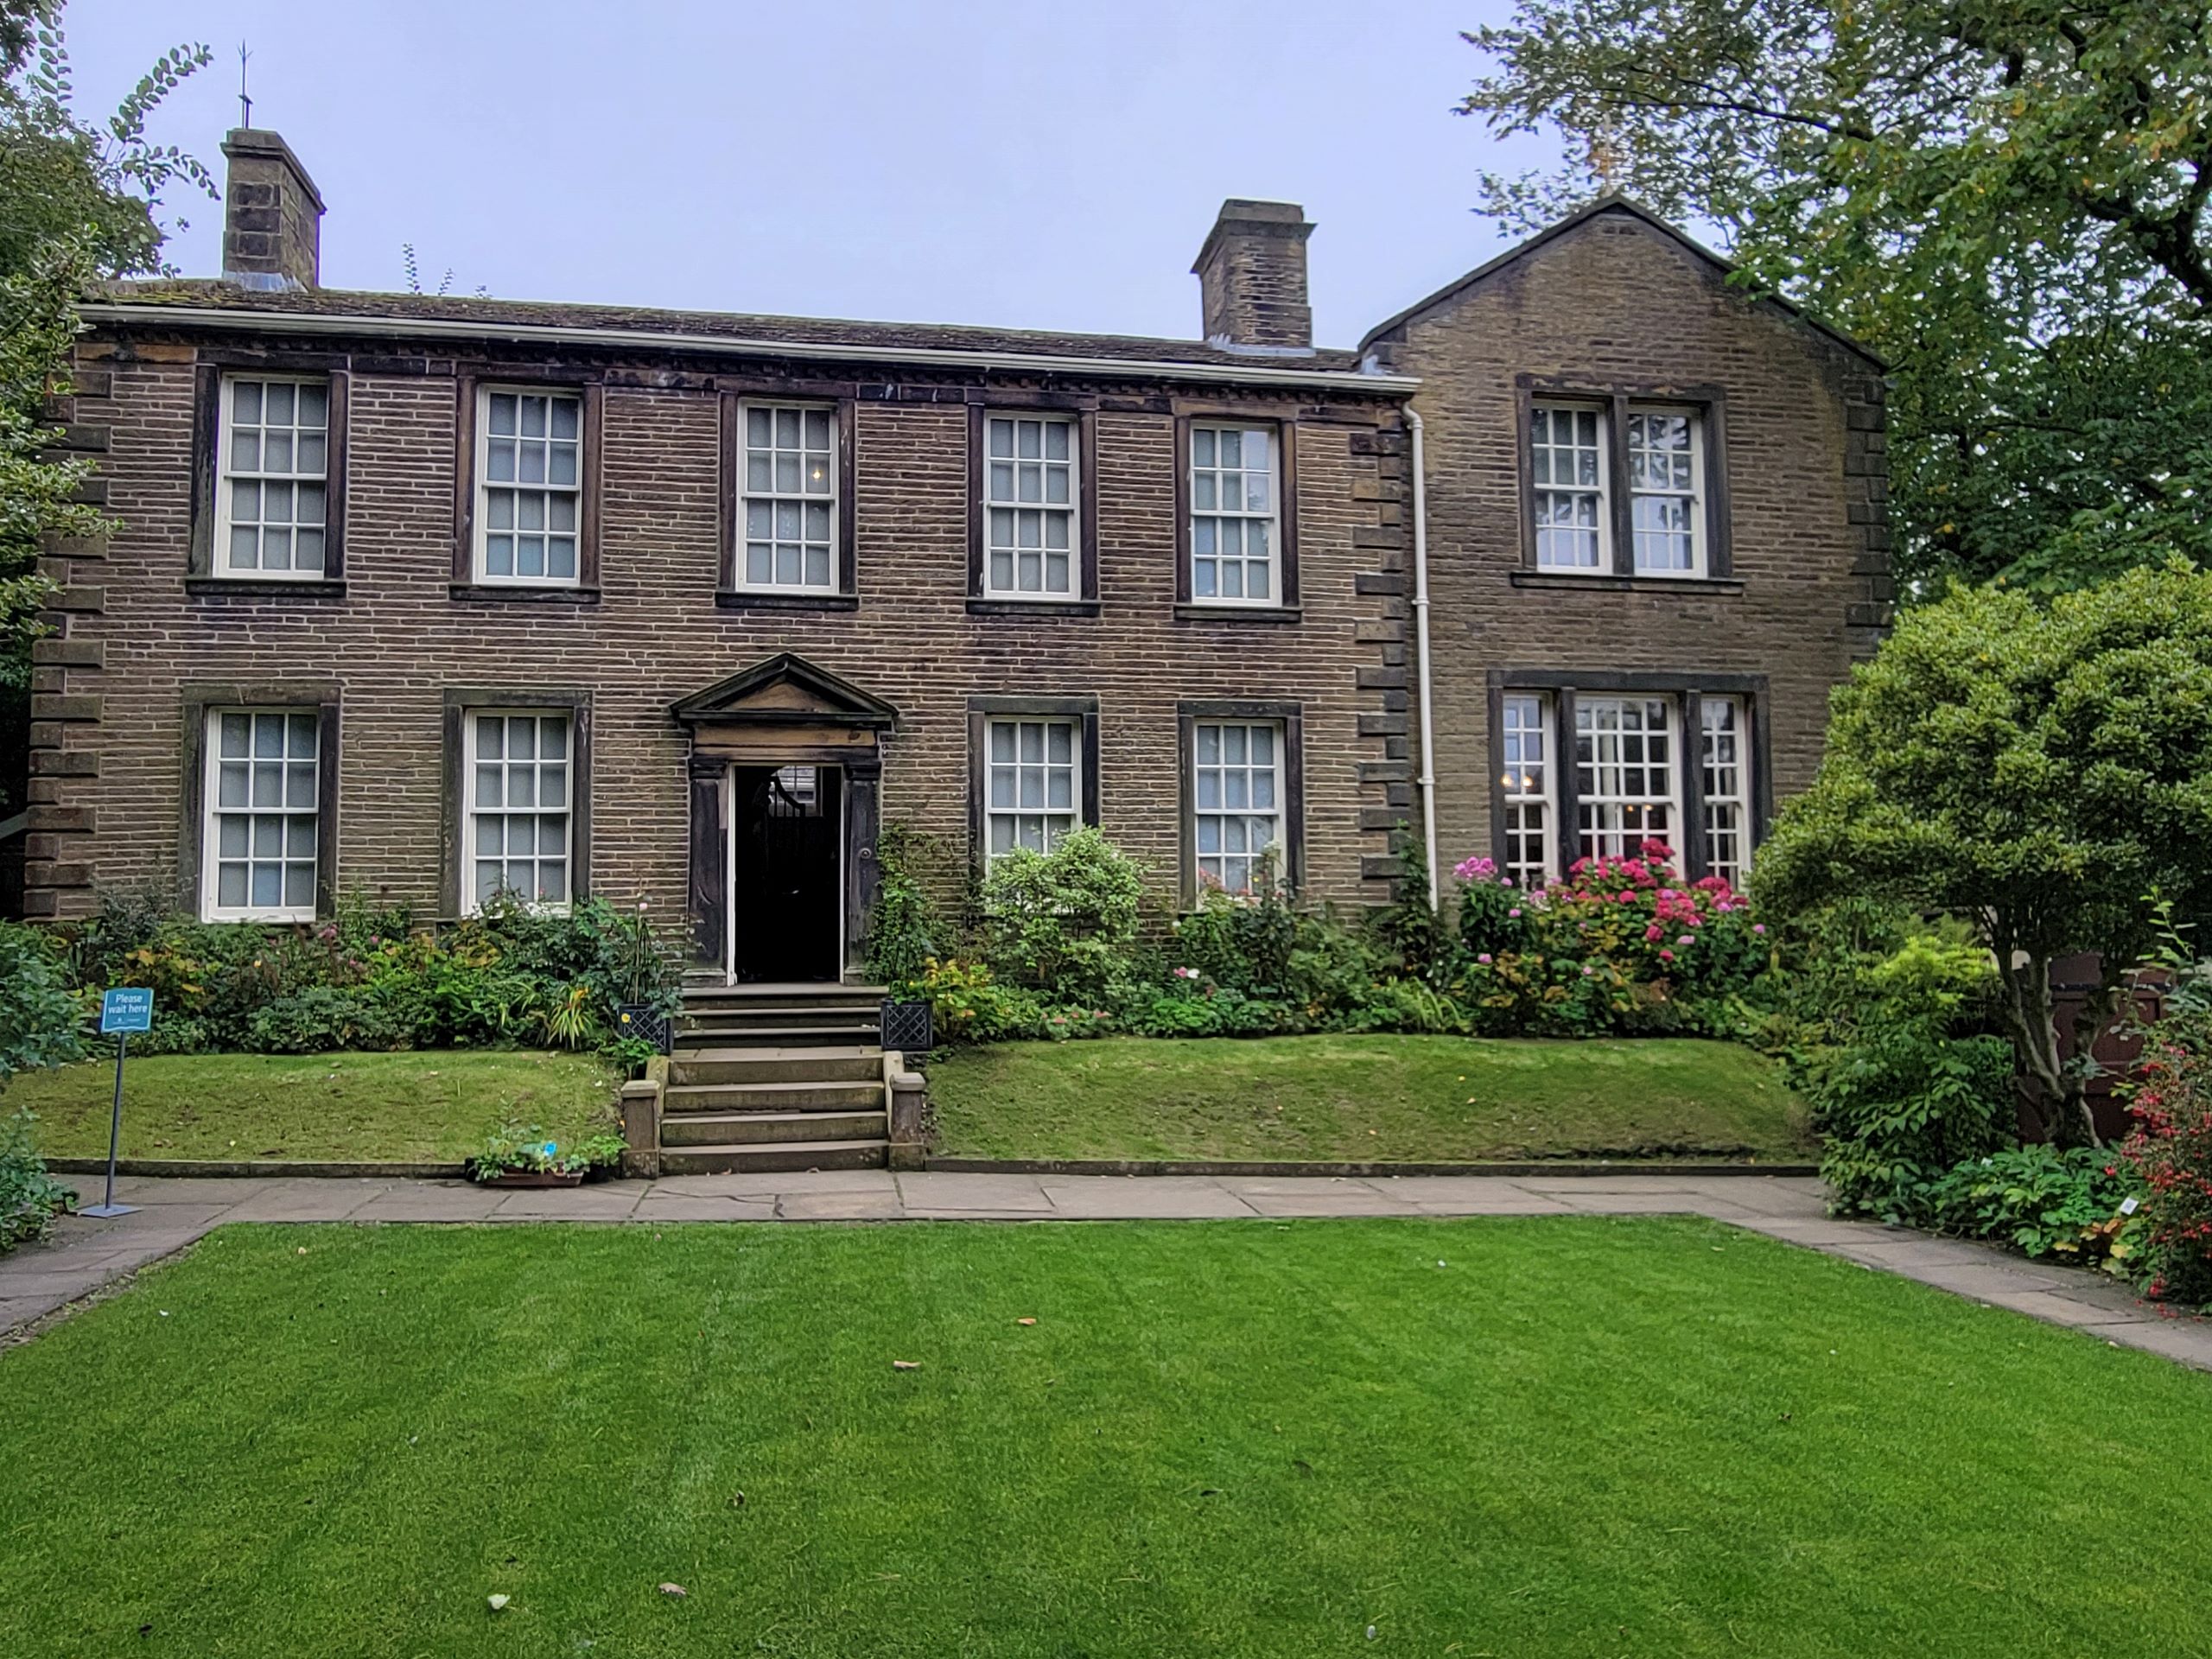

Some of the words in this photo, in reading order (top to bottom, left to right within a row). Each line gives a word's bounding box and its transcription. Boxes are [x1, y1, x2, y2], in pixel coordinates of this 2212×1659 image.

[115, 994, 143, 1003] Please
[108, 1005, 126, 1014] wait
[128, 1004, 148, 1014] here
